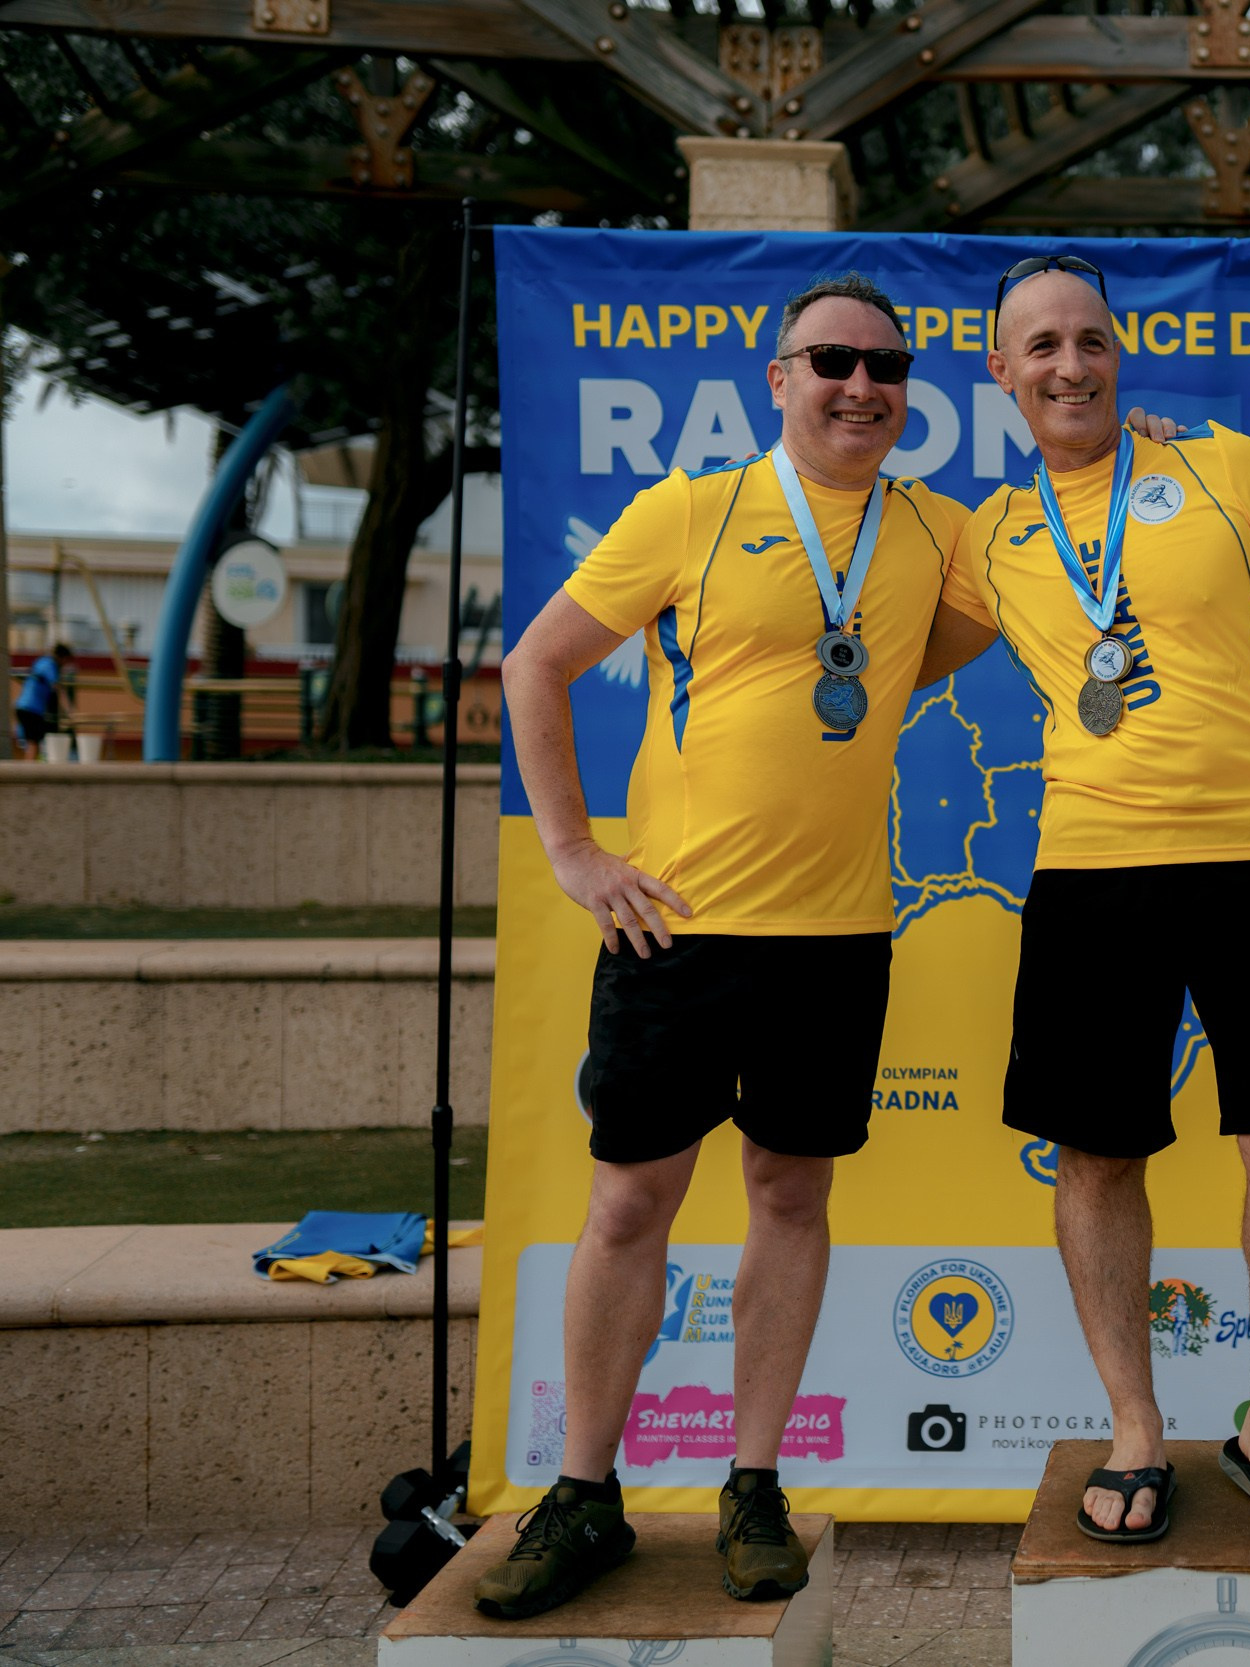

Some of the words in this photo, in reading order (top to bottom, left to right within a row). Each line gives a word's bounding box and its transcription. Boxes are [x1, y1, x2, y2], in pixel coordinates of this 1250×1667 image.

[573, 304, 769, 348] HAPPY
[579, 377, 1037, 481] RAOM
[882, 1067, 958, 1080] OLYMPIAN
[900, 1268, 938, 1312] FLORIDA
[940, 1263, 967, 1273] FOR
[969, 1266, 1008, 1312] UKRAINE
[688, 1309, 728, 1325] CLUB
[683, 1327, 735, 1343] MIAMI
[900, 1332, 959, 1374] FL4UA.ORG
[968, 1332, 1007, 1371] @FL4UA
[785, 1413, 831, 1430] UDIO
[979, 1416, 1178, 1430] PHOTOGRAR
[636, 1434, 681, 1444] PAINTING
[682, 1434, 725, 1444] CLASSES
[782, 1435, 795, 1444] RT
[797, 1436, 803, 1444] &
[805, 1436, 831, 1444] WINE
